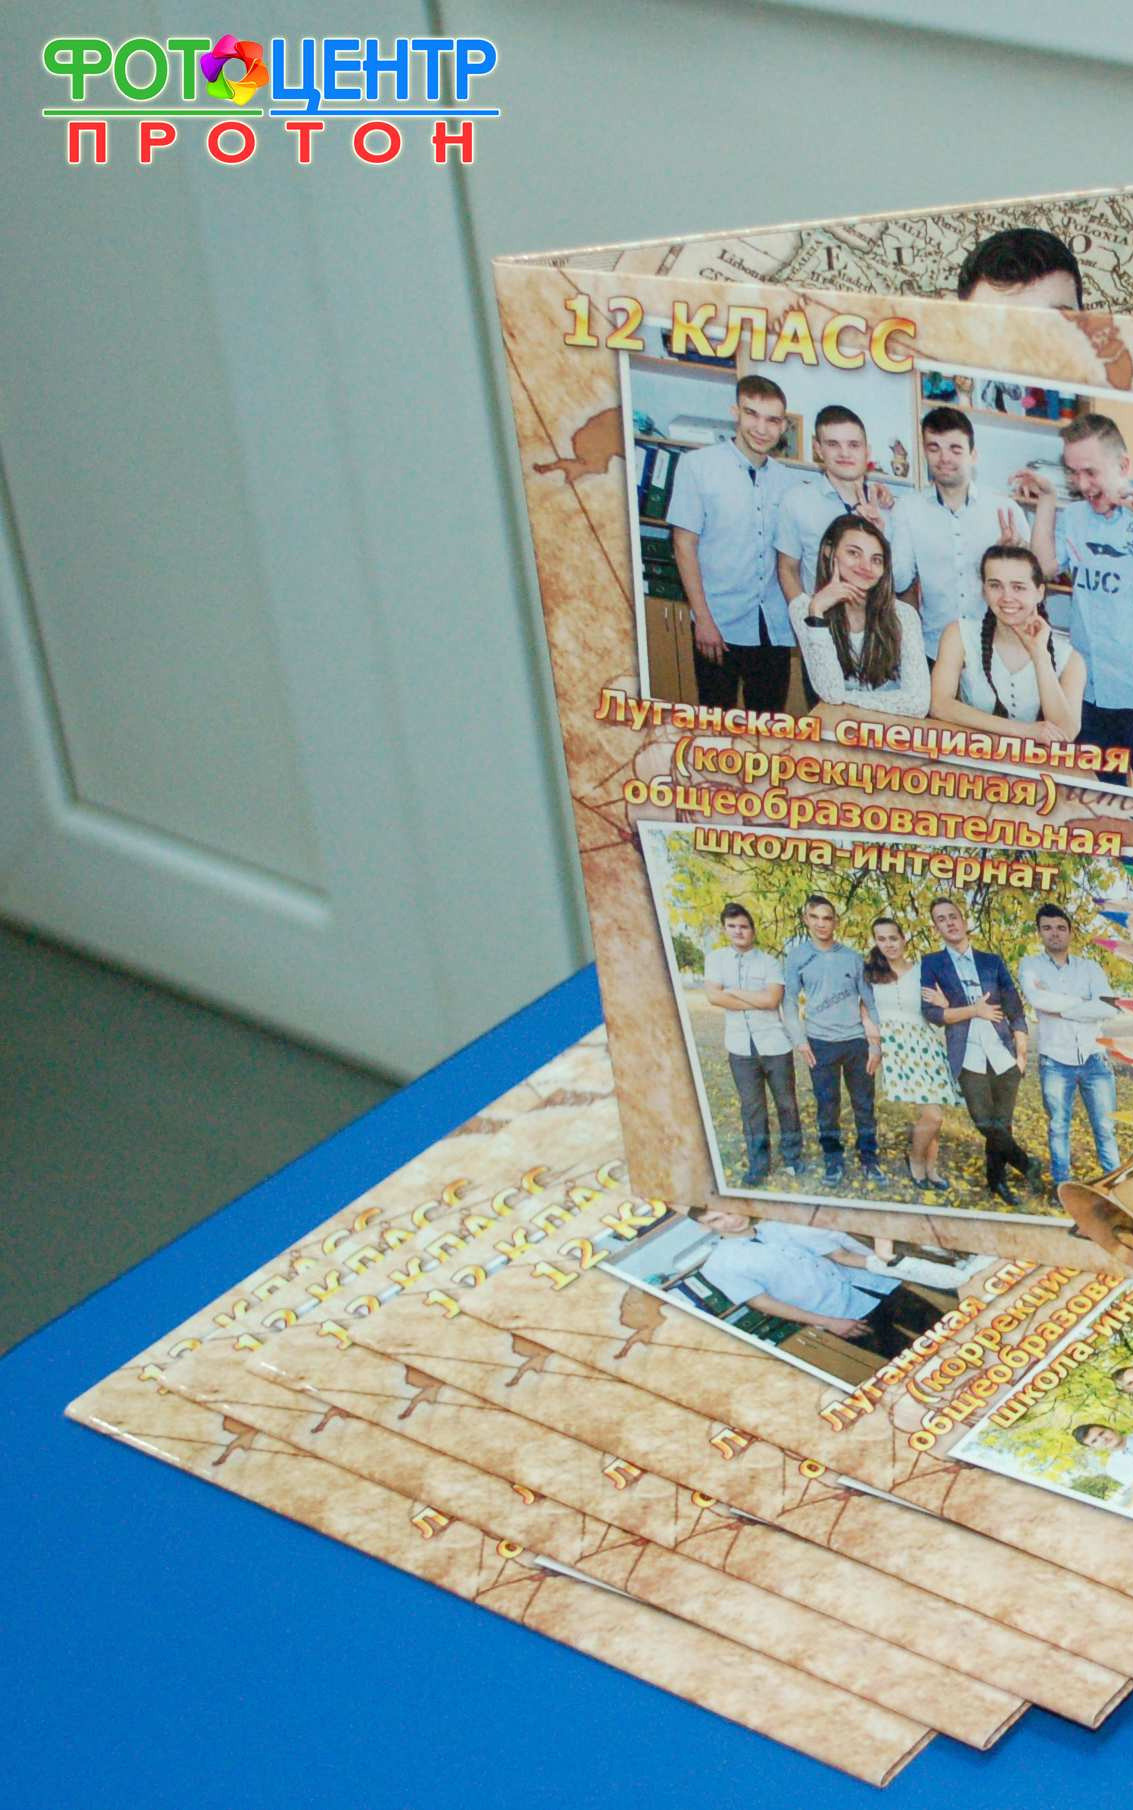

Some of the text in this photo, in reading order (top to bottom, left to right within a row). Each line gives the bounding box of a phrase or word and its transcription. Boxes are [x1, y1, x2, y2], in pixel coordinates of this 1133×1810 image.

[563, 293, 918, 374] 12 КЛАСС
[595, 688, 1131, 775] Луганская специальная
[624, 776, 1123, 857] общеобразовательная
[674, 737, 1057, 815] (коррекционная)
[694, 827, 1059, 891] школа-интернат
[531, 1238, 609, 1292] 12
[819, 1296, 988, 1433] Луганская
[906, 1266, 1082, 1405] (коррекцио
[908, 1271, 1126, 1453] общеобразова
